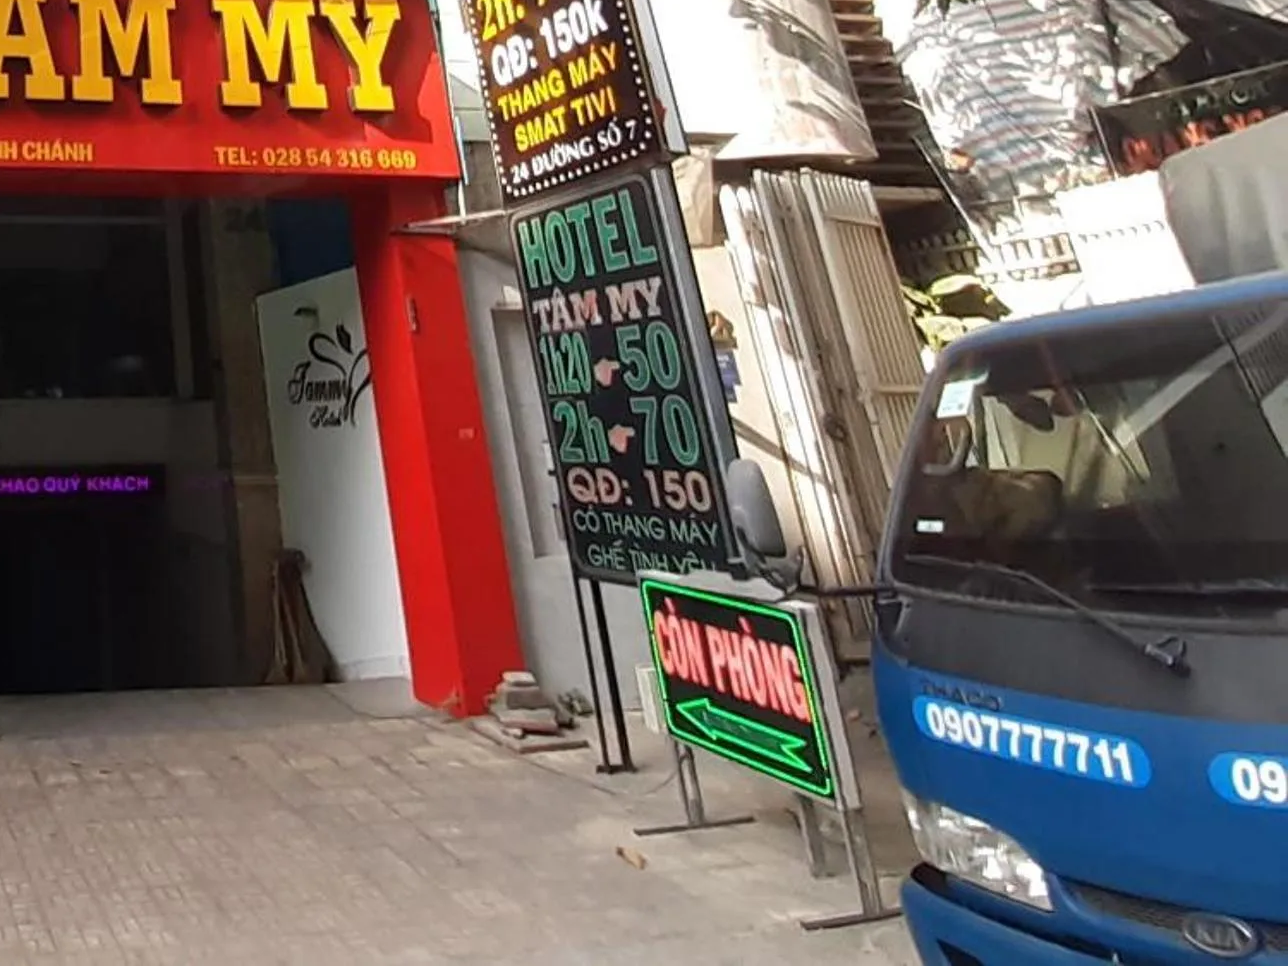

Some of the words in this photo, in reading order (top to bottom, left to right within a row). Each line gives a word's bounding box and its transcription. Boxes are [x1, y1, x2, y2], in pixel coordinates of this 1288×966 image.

[497, 68, 566, 122] THANG
[568, 42, 616, 90] MÁY
[21, 137, 93, 162] CHÁNH
[510, 161, 529, 184] 24
[596, 116, 622, 152] SỐ
[625, 119, 637, 140] 7
[514, 106, 566, 152] SMAT
[570, 86, 616, 127] TIVI
[214, 146, 258, 166] TEL:
[262, 147, 301, 167] 028
[305, 148, 331, 167] 54
[518, 189, 658, 288] HOTEL
[532, 286, 603, 334] TÂM
[605, 276, 663, 324] MY
[539, 330, 592, 396] 1h20
[615, 320, 681, 392] 50
[552, 400, 611, 465] 2h
[630, 394, 701, 466] 70
[573, 505, 600, 533] CÓ
[602, 511, 665, 541] THANG
[643, 469, 712, 512] 150
[654, 596, 710, 688] CÒN
[704, 616, 811, 724] PHÒNG
[925, 702, 1134, 783] 0907777711
